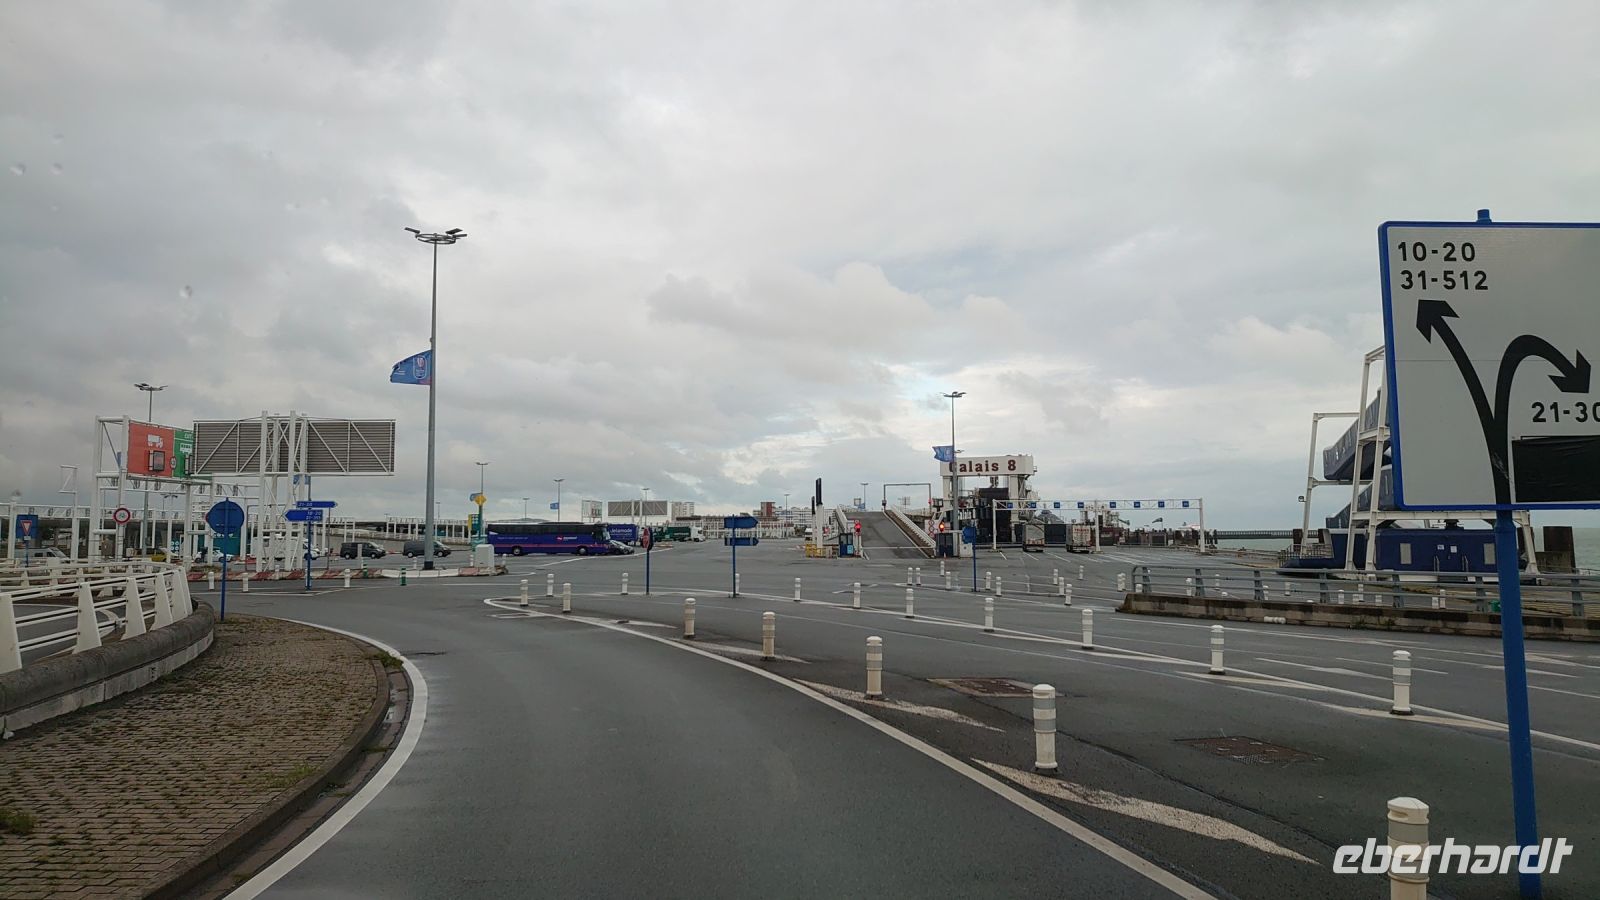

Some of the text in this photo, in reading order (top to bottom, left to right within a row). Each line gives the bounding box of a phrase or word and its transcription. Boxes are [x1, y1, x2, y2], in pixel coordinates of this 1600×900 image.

[1398, 242, 1475, 261] 10-20
[1400, 270, 1488, 290] 31-512
[1531, 401, 1600, 423] 21-30
[1007, 459, 1017, 472] 8
